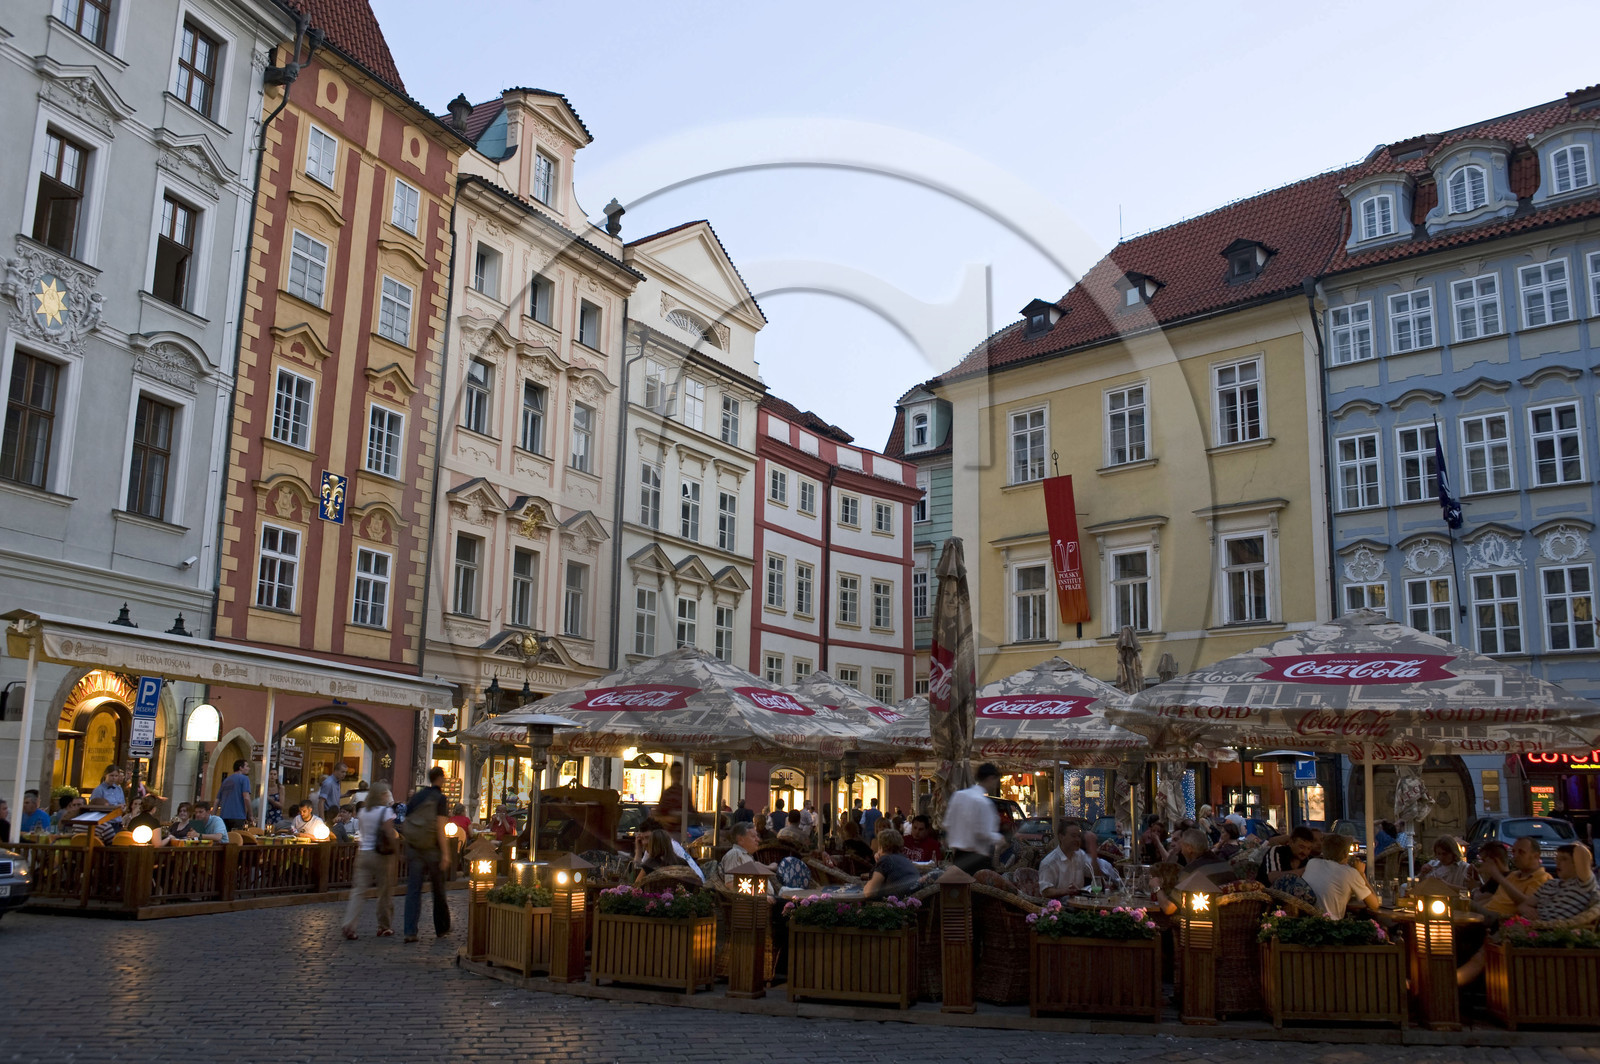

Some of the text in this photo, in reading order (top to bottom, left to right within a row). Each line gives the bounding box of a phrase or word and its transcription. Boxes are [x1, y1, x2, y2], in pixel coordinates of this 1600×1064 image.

[1058, 577, 1082, 585] INSTITUT
[136, 653, 191, 669] TAVERNA TOSCANA
[1283, 660, 1427, 678] Coca-Cola
[269, 673, 311, 687] TAVERNA TOSCANA
[483, 663, 491, 676] U
[525, 669, 565, 686] KORUNY
[59, 672, 104, 724] TAVERNA
[141, 681, 157, 704] P
[587, 690, 683, 708] Coca-Cola
[751, 692, 804, 712] Coca-Cola
[982, 700, 1080, 715] Coca-Cola
[1157, 705, 1251, 719] ICE COLD
[1424, 708, 1554, 722] SOLD HERE
[1297, 709, 1397, 737] Coca-Cola
[568, 732, 625, 755] Coca-Cola
[642, 733, 716, 743] SOLD HERE
[1061, 738, 1142, 748] SOLD HERE
[981, 739, 1044, 760] Coca-Cola
[778, 772, 793, 780] BLUE
